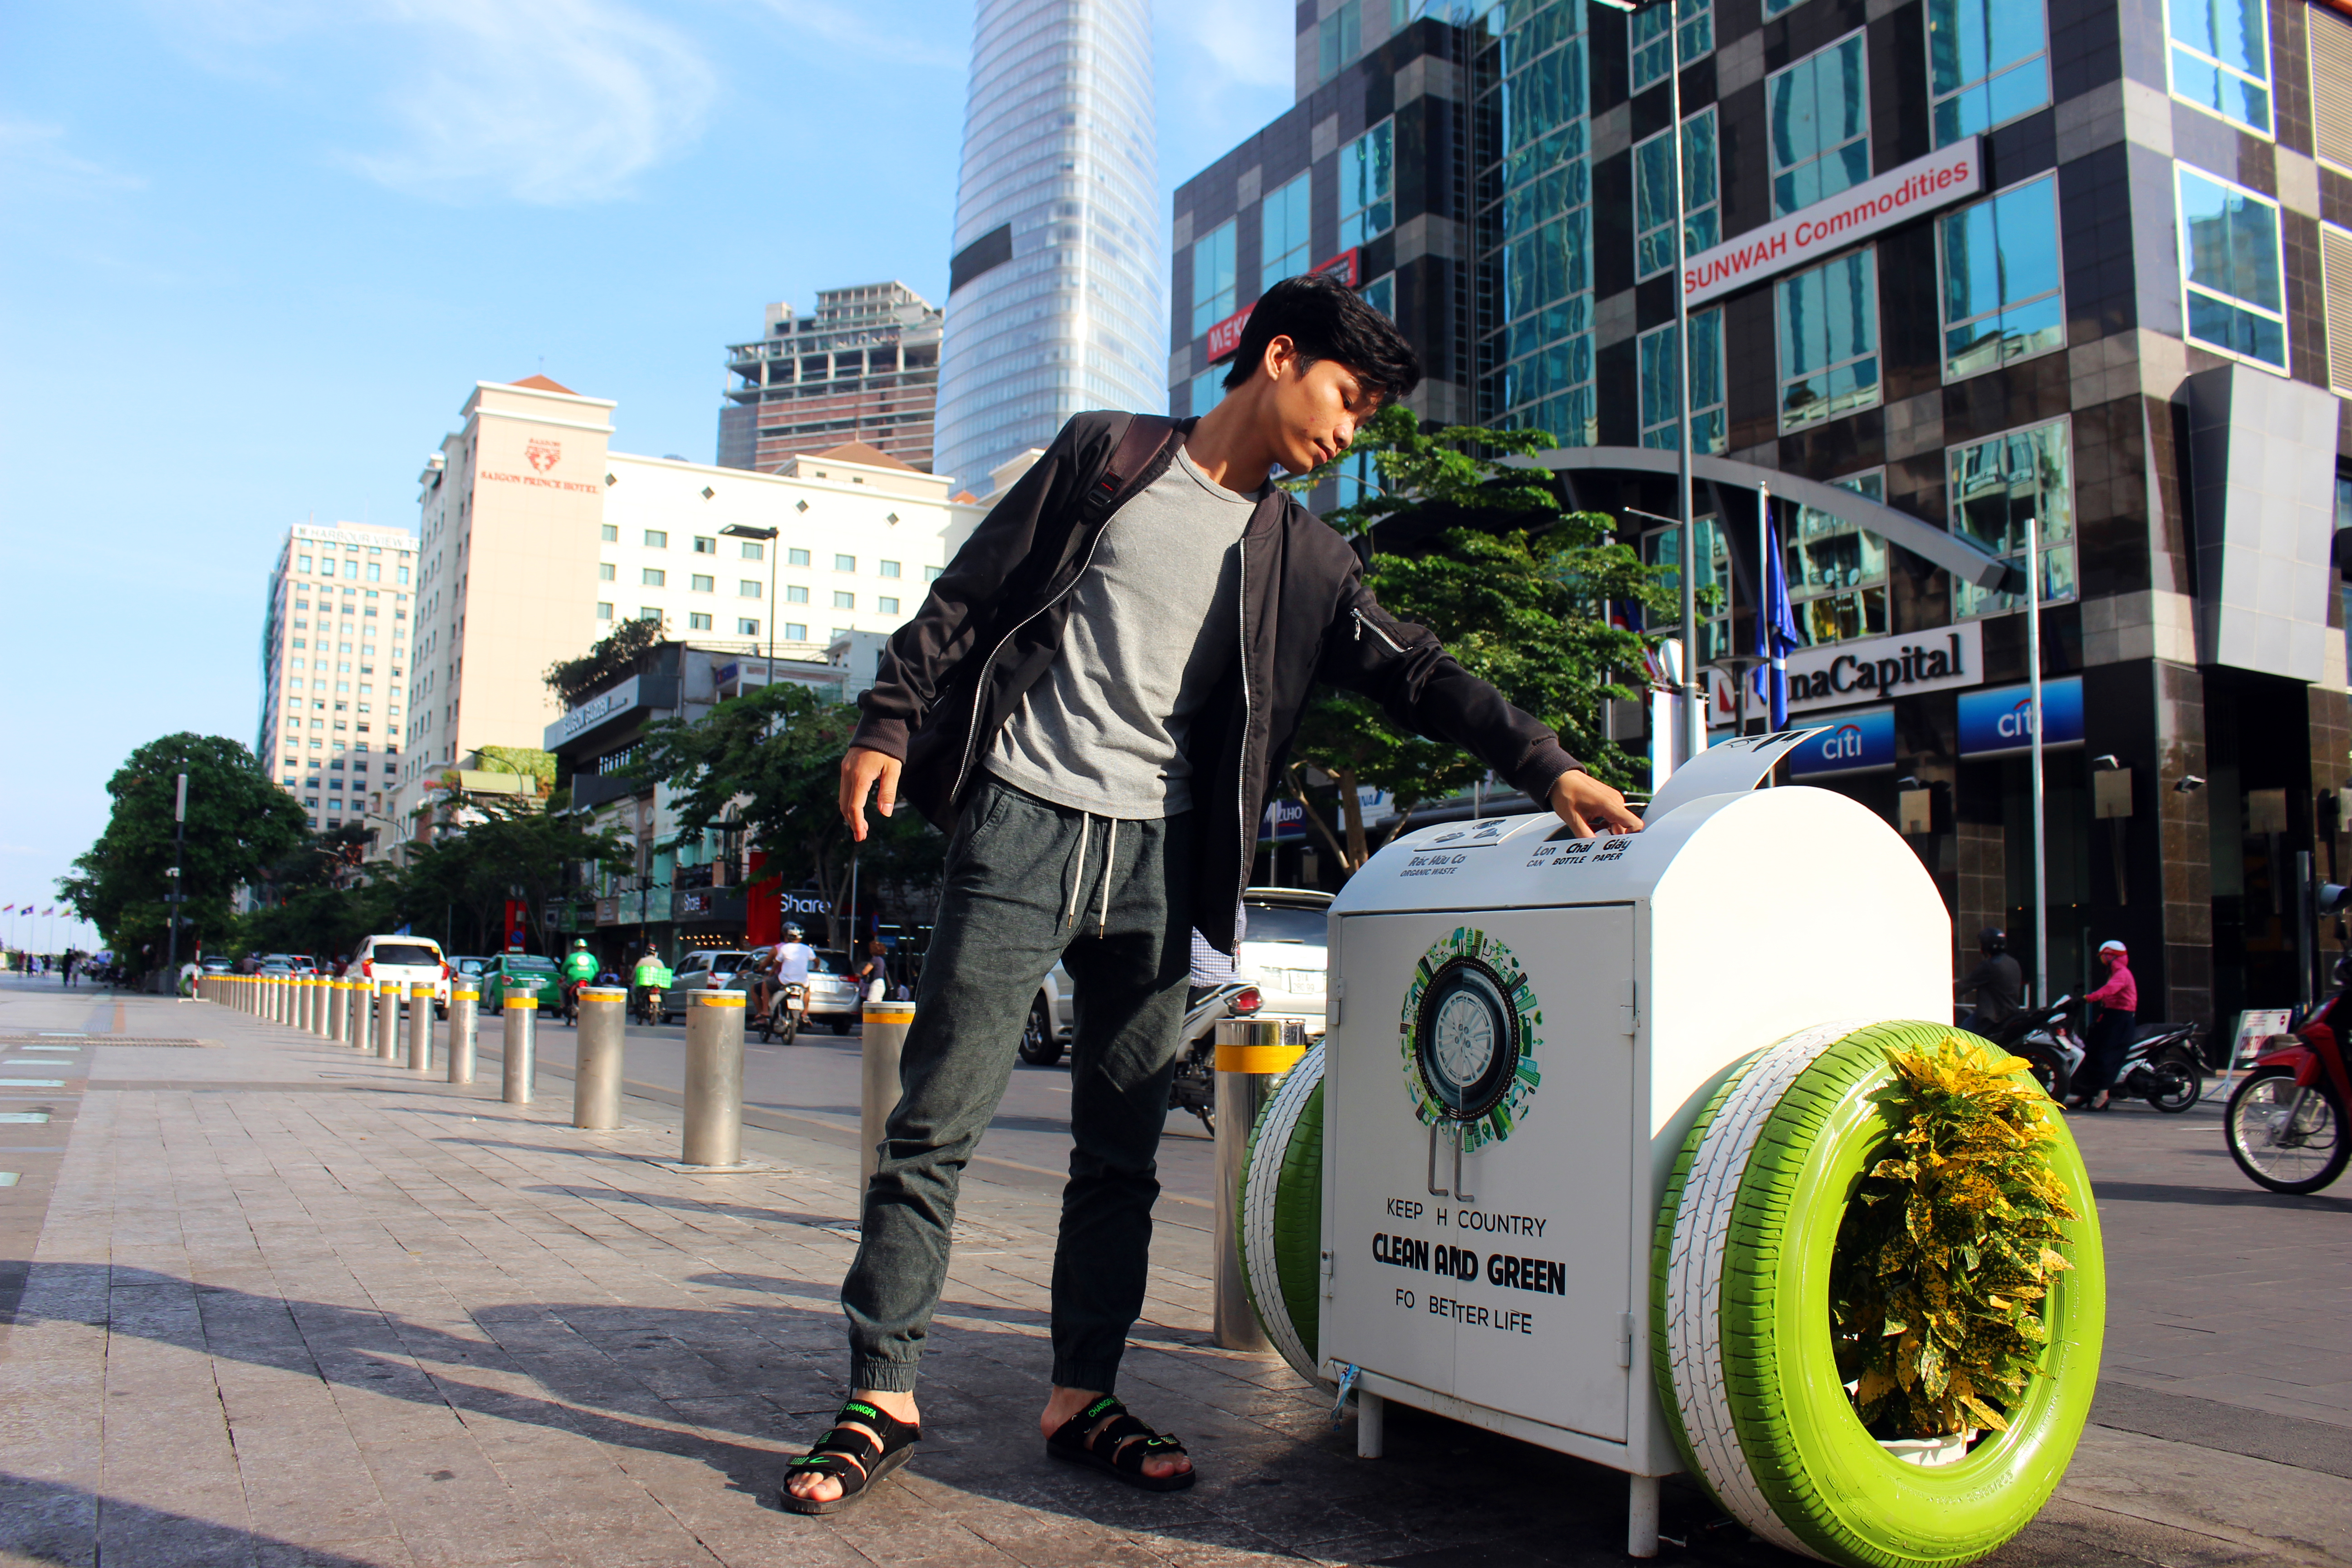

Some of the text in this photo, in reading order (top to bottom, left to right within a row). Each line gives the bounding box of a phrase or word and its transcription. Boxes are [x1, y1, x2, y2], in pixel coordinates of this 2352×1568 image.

[1685, 162, 1968, 294] SUNWAH Commodities
[481, 471, 600, 495] SAIGON PRINCE HOTEL
[1755, 633, 1963, 700] naCapital
[1997, 706, 2042, 738] cit
[1822, 730, 1862, 760] citi
[1526, 853, 1623, 867] CAN BOTTLE PAPER
[1532, 837, 1632, 857] Lon Chai Giấy
[1400, 867, 1458, 877] ORGANIC WASTE
[1408, 856, 1430, 867] Rác
[1387, 1198, 1546, 1237] KEEP H COUNTRY
[1372, 1232, 1566, 1296] CLEAN AND GREEN
[1396, 1288, 1532, 1334] FO BETTER LIFE
[847, 1403, 877, 1420] CHANGFA
[1088, 1398, 1115, 1417] CHANGFA
